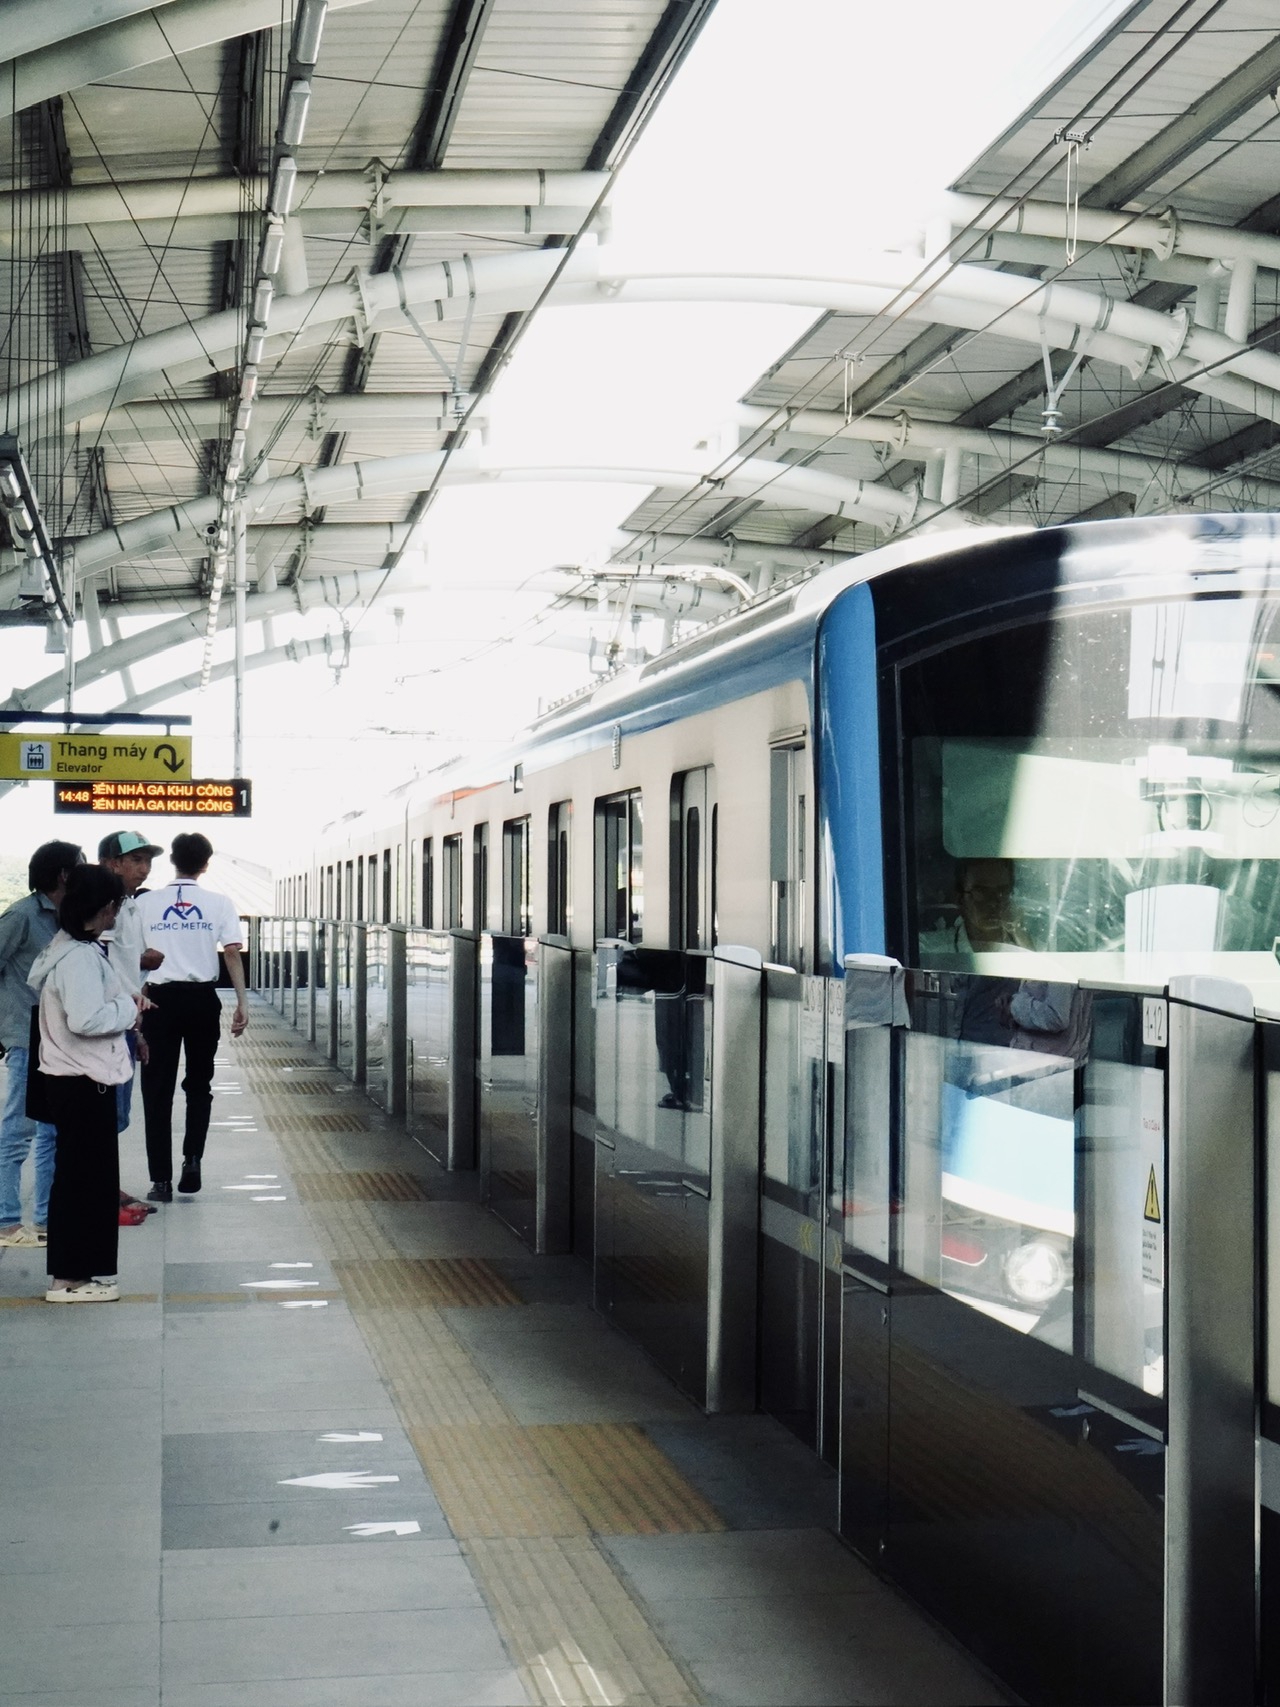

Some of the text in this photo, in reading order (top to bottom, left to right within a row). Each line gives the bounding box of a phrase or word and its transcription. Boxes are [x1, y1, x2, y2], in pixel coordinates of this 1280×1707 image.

[58, 742, 148, 761] Thang máy
[57, 762, 103, 773] Elevator
[146, 784, 166, 796] GA
[167, 785, 193, 796] KHU
[196, 783, 234, 797] CÔNG
[59, 791, 90, 802] 14:48
[146, 799, 166, 811] GA
[167, 800, 193, 811] KHU
[196, 798, 234, 812] CÔNG
[150, 922, 178, 931] HCMC
